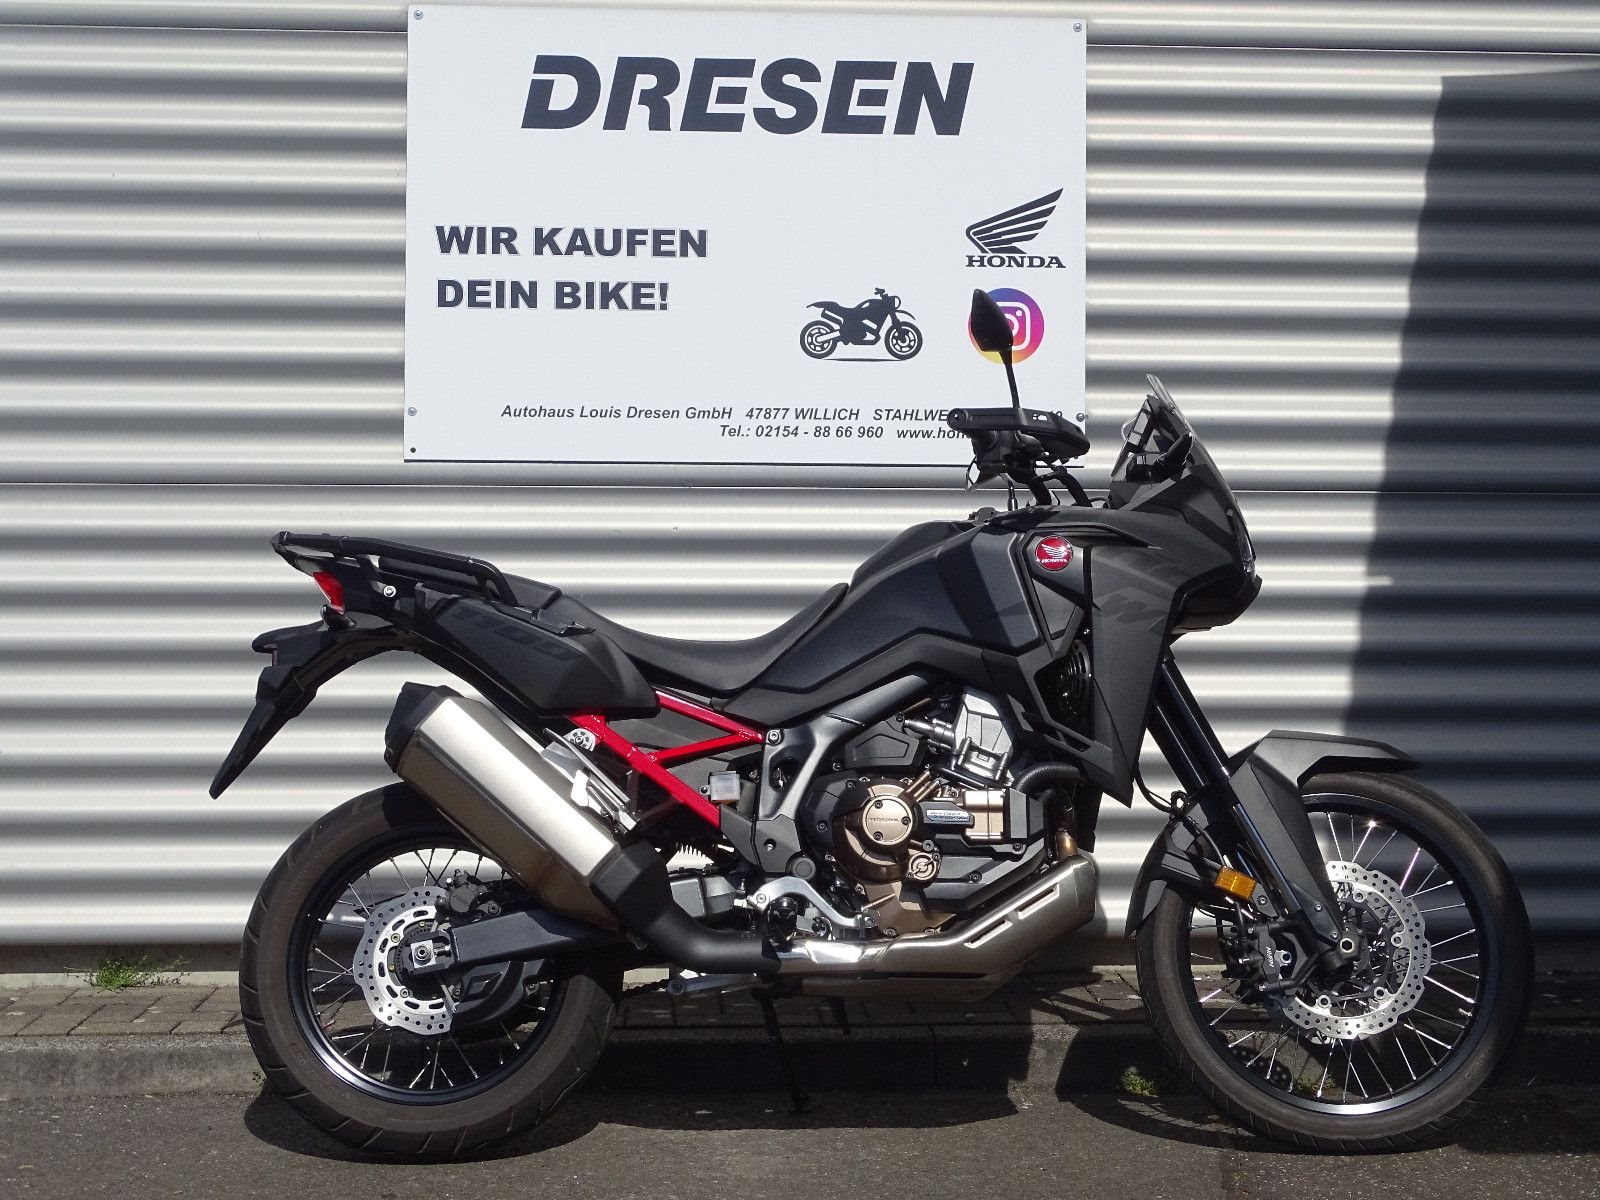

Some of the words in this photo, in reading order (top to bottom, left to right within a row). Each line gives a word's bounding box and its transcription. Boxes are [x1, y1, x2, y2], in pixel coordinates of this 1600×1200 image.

[521, 54, 975, 136] DRESEN
[435, 225, 520, 256] WIR
[533, 226, 708, 259] KAUFEN
[965, 255, 1066, 268] HONDA
[436, 278, 539, 309] DEIN
[554, 280, 669, 311] BIKE!
[500, 404, 575, 418] Autohaus
[579, 405, 622, 419] Louis
[626, 406, 680, 419] Dresen
[685, 406, 733, 420] GmbH
[745, 407, 790, 420] 47877
[794, 407, 860, 421] WILLICH
[873, 408, 949, 422] STAHLWE
[720, 424, 750, 437] Tel.:
[755, 425, 799, 438] 02154
[813, 425, 831, 439] 88
[835, 425, 853, 439] 66
[857, 426, 884, 439] 960
[896, 427, 969, 440] www.hon
